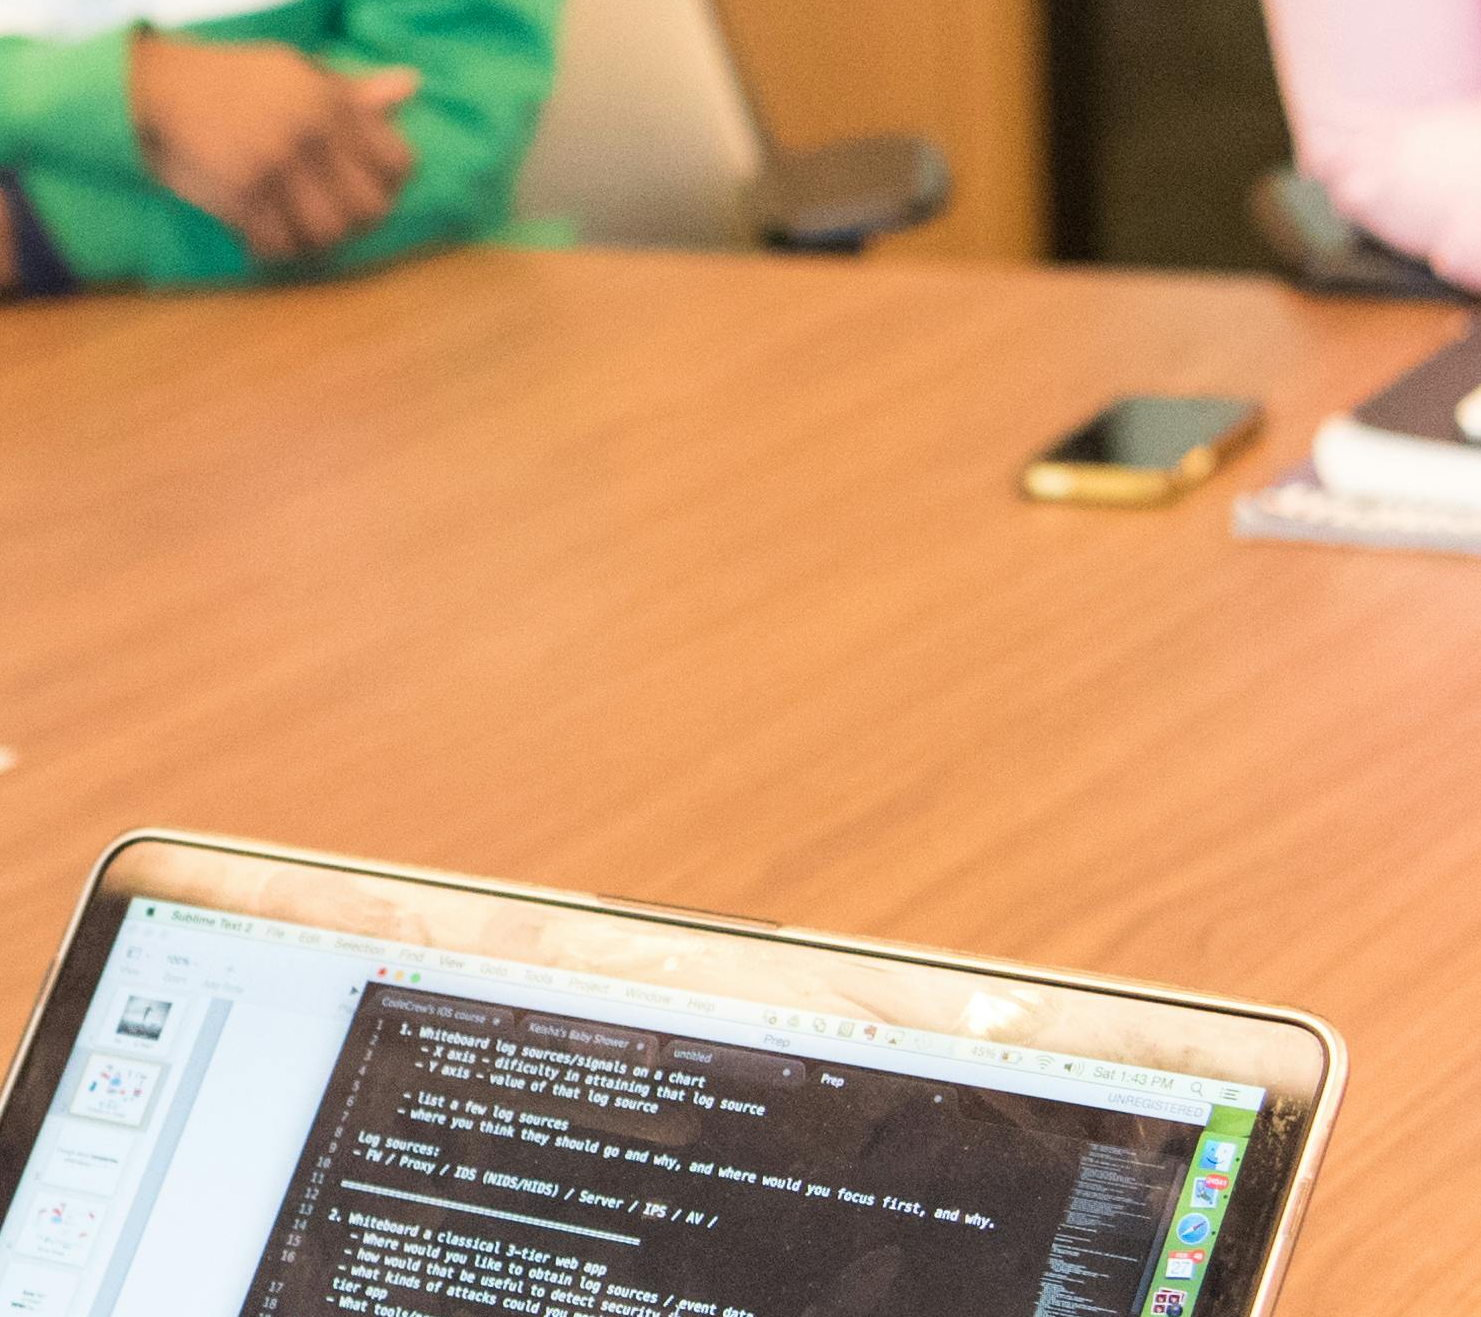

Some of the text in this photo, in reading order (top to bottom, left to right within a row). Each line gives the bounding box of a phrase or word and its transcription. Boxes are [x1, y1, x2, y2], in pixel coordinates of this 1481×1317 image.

[171, 910, 217, 926] Sublime
[218, 918, 245, 931] Text
[762, 1033, 792, 1048] Prep
[419, 1026, 705, 1088] Whiteboard log sources/signals on a chart
[432, 1045, 765, 1115] X axis dificulty in attaining that log source
[819, 1073, 846, 1088] Prep
[1092, 1066, 1174, 1090] Sat 1:43 PM
[1106, 1091, 1204, 1118] UNREGISTERED
[357, 1130, 439, 1156] Log sources:
[365, 1147, 704, 1224] FW Proxy IDS (NIDS/HIDS) Server IPS AV
[348, 1212, 607, 1277] Whiteboard a classical 3-tier web app
[338, 1295, 367, 1312] What
